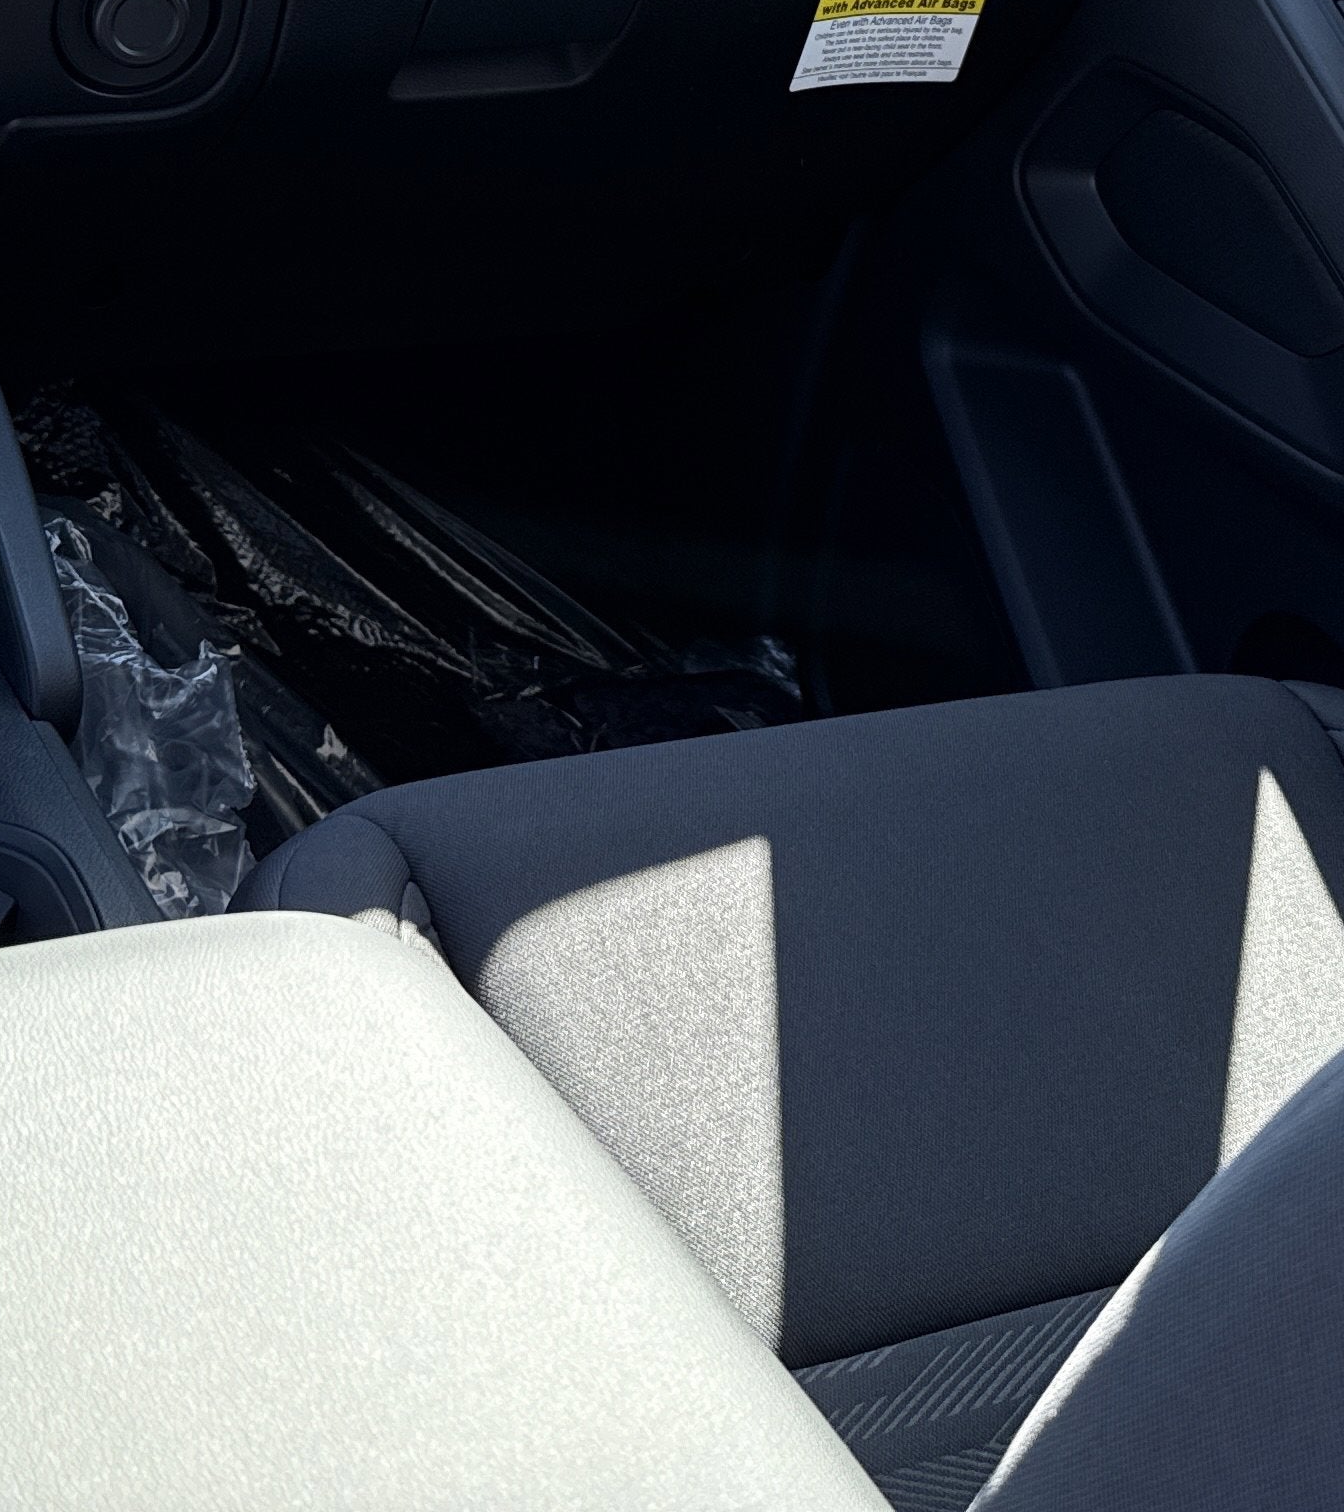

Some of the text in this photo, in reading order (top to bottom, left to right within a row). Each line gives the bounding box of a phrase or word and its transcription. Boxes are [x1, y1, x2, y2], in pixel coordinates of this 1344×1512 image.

[822, 1, 848, 15] with
[830, 16, 952, 30] Even with Advanced Air Bags
